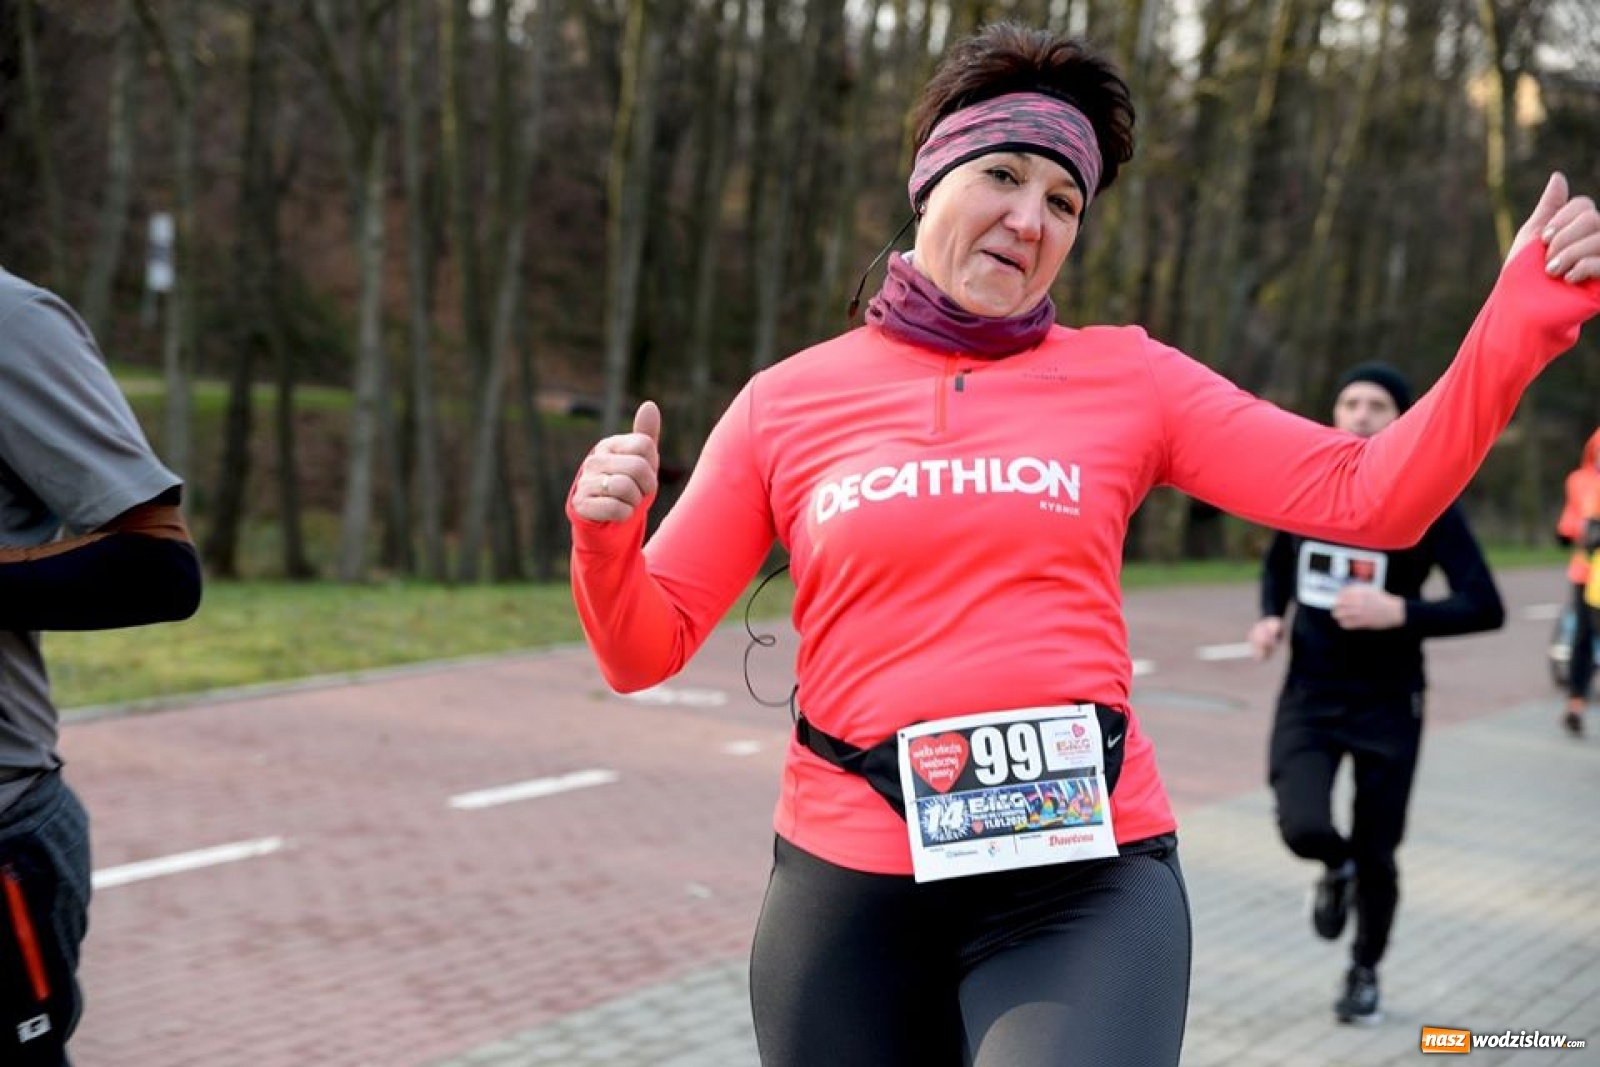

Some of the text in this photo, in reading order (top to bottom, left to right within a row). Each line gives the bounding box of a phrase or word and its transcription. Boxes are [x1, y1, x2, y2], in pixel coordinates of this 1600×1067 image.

[816, 456, 1080, 523] DECATHLON
[970, 723, 1043, 786] 99
[927, 801, 964, 833] 14
